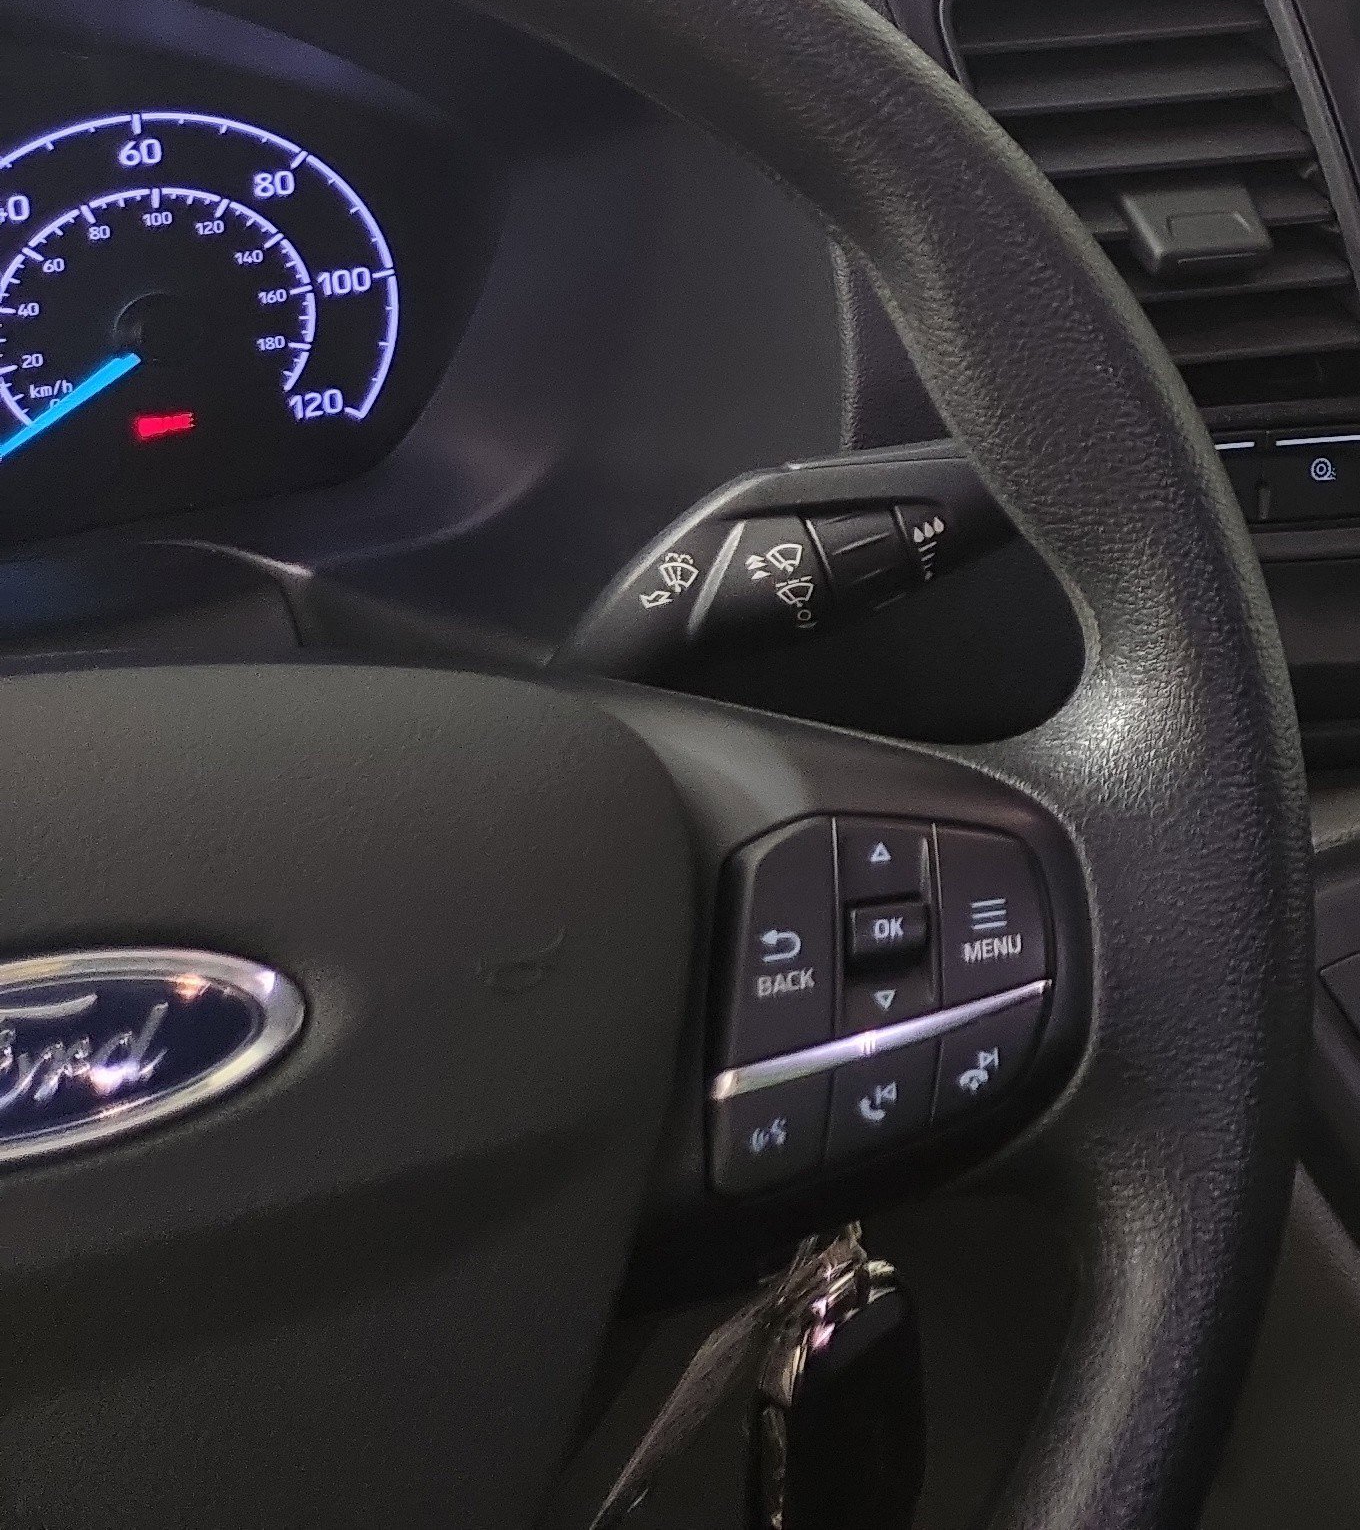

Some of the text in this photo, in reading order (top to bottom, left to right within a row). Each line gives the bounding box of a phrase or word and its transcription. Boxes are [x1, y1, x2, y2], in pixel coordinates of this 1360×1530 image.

[118, 139, 162, 166] 60
[253, 171, 295, 197] 80
[142, 212, 172, 227] 100
[89, 226, 110, 240] 80
[196, 221, 224, 236] 120
[234, 250, 264, 265] 140
[43, 258, 65, 273] 60
[318, 268, 371, 295] 100
[258, 290, 287, 304] 160
[17, 303, 39, 317] 40
[257, 336, 285, 350] 180
[22, 354, 43, 368] 20
[29, 380, 73, 398] km/h
[289, 389, 344, 420] 120
[874, 917, 903, 940] OK
[963, 933, 1023, 963] MENU
[756, 968, 815, 998] BACK
